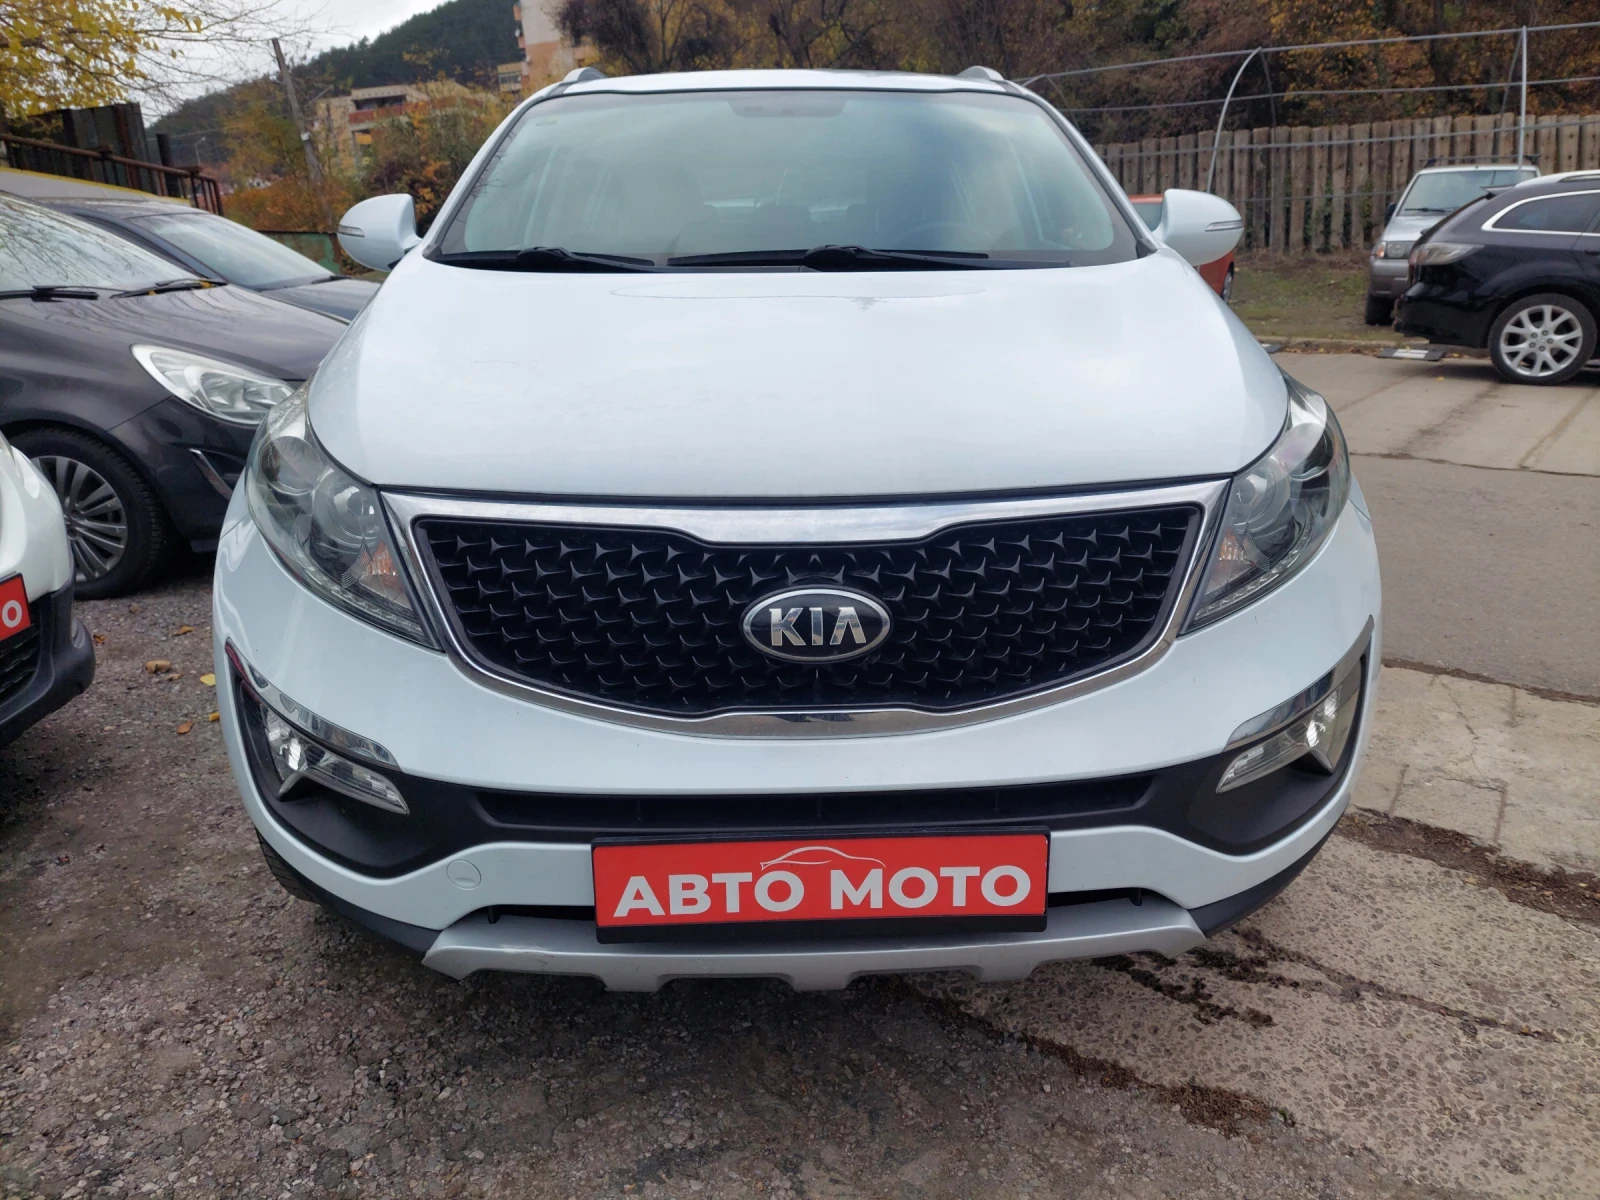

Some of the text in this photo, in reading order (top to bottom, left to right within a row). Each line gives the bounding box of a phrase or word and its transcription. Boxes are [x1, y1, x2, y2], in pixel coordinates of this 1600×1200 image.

[769, 606, 867, 646] KIA
[613, 865, 1031, 917] АВТО МОТО
